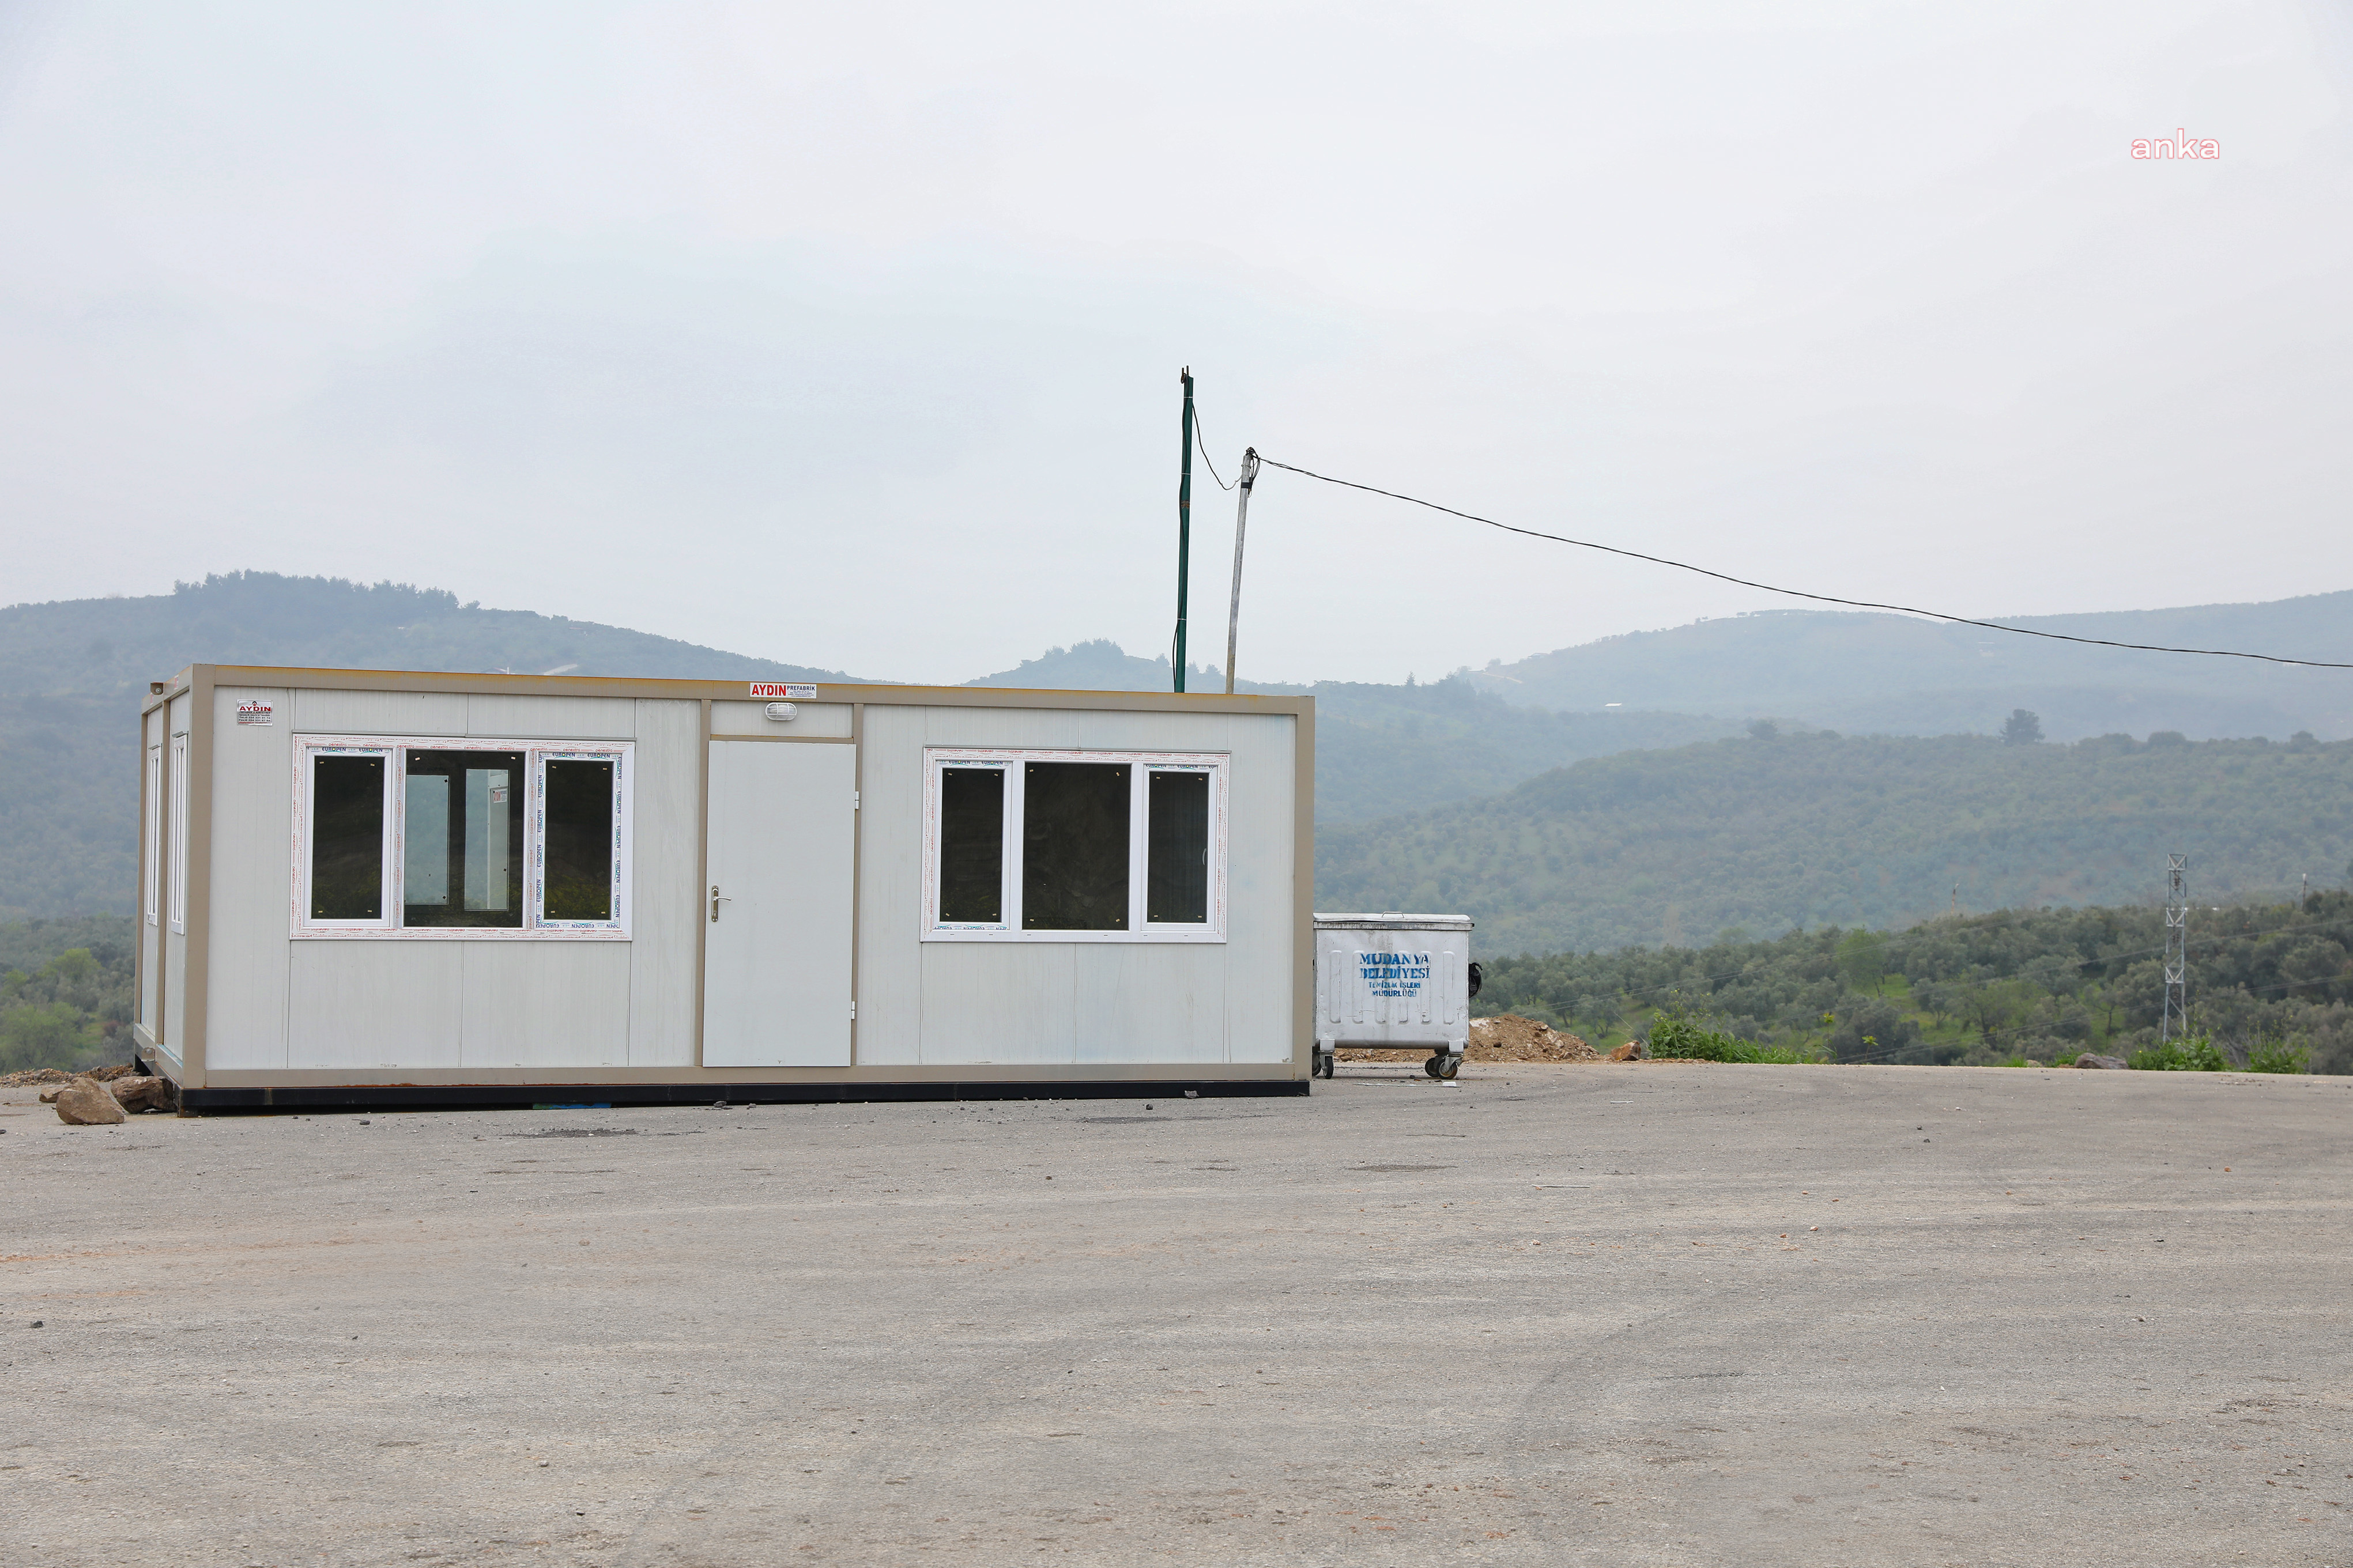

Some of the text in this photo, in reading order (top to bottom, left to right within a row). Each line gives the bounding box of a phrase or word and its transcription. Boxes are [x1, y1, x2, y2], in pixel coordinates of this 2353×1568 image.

[752, 685, 786, 696] AYDIN
[1359, 953, 1429, 965] MUDANYA
[1359, 966, 1430, 978] BELEDİYESİ
[1372, 988, 1417, 997] MÜDÜRLÜĞÜ
